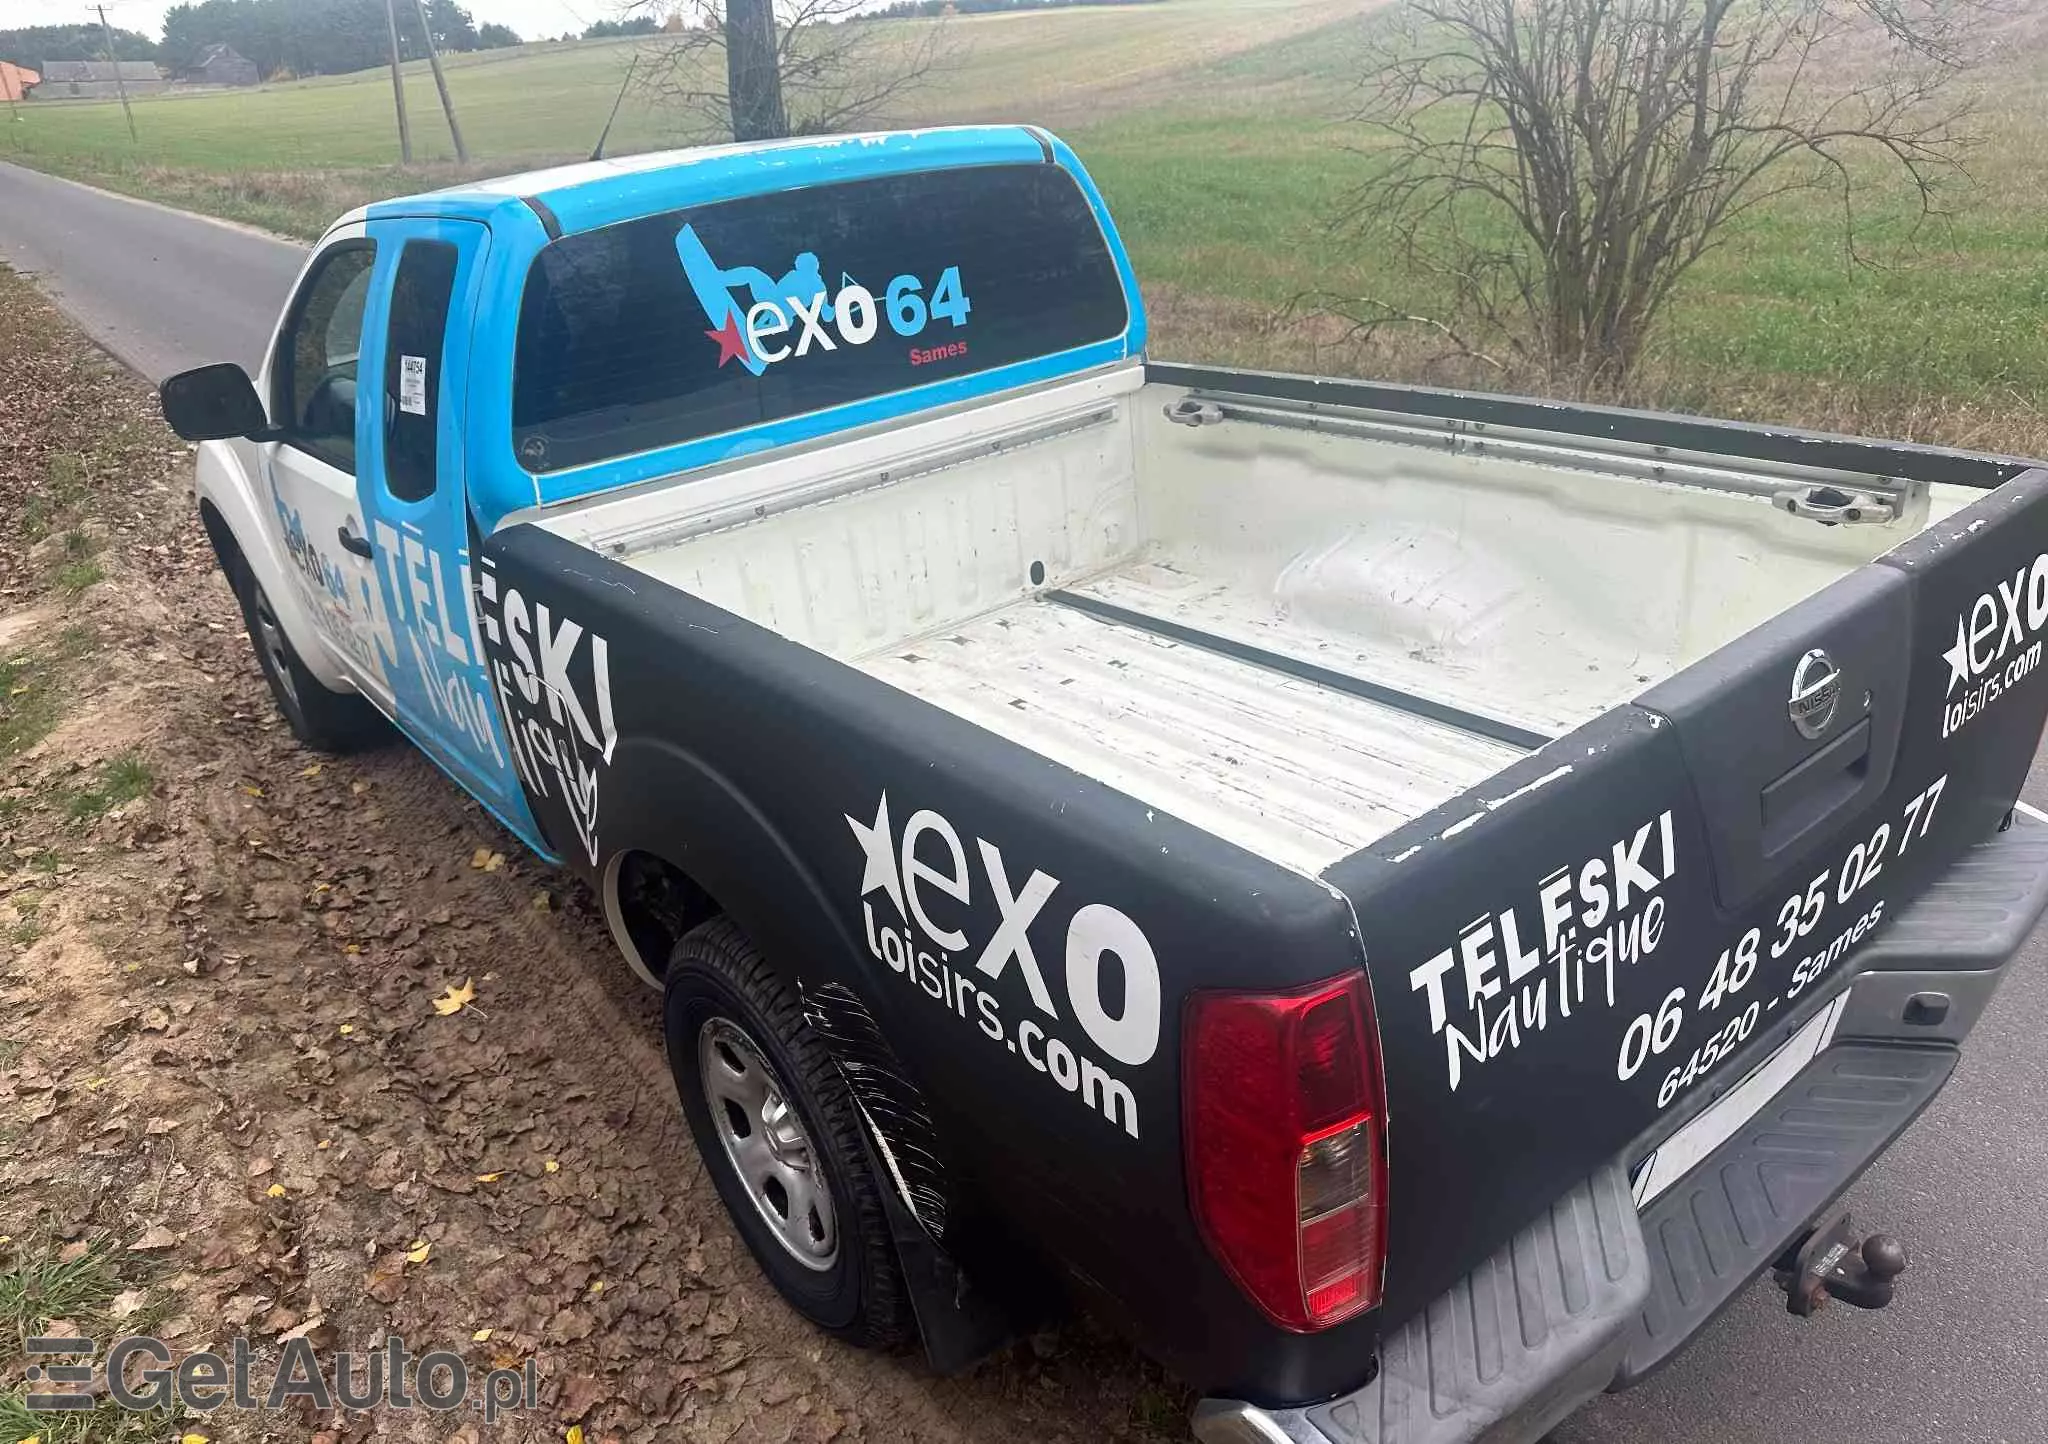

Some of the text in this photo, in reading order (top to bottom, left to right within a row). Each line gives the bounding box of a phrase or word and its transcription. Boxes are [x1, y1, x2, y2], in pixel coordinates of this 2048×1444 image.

[746, 265, 971, 363] exo 64
[909, 340, 968, 365] Sames
[1942, 640, 2043, 740] loisirs.com
[862, 900, 1140, 1140] loisirs.com
[901, 808, 1162, 1066] exo
[1445, 895, 1666, 1092] Nautique
[1617, 773, 1948, 1081] 06 48 35 02 77
[1657, 1000, 1760, 1109] 64520
[1787, 900, 1885, 999] Sames
